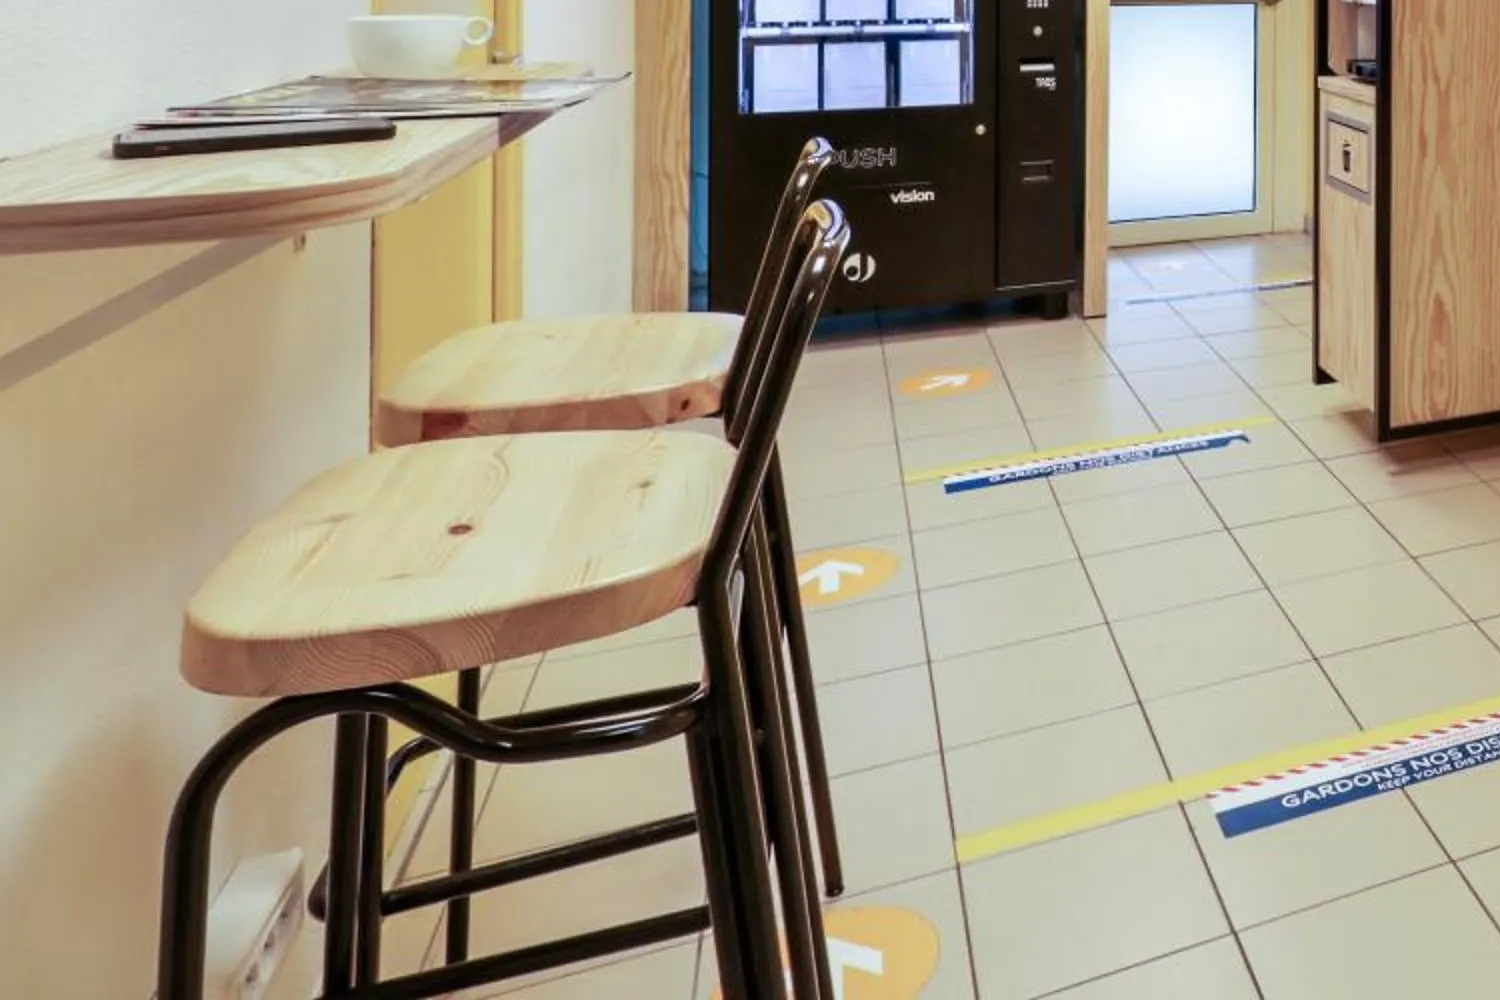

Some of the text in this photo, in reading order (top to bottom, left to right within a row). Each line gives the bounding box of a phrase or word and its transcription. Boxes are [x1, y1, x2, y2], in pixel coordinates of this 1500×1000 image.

[889, 189, 935, 204] vision
[1281, 763, 1407, 808] GARDONS
[1410, 747, 1463, 772] NOS
[1377, 775, 1411, 791] KEEP
[1414, 764, 1451, 779] YOUR
